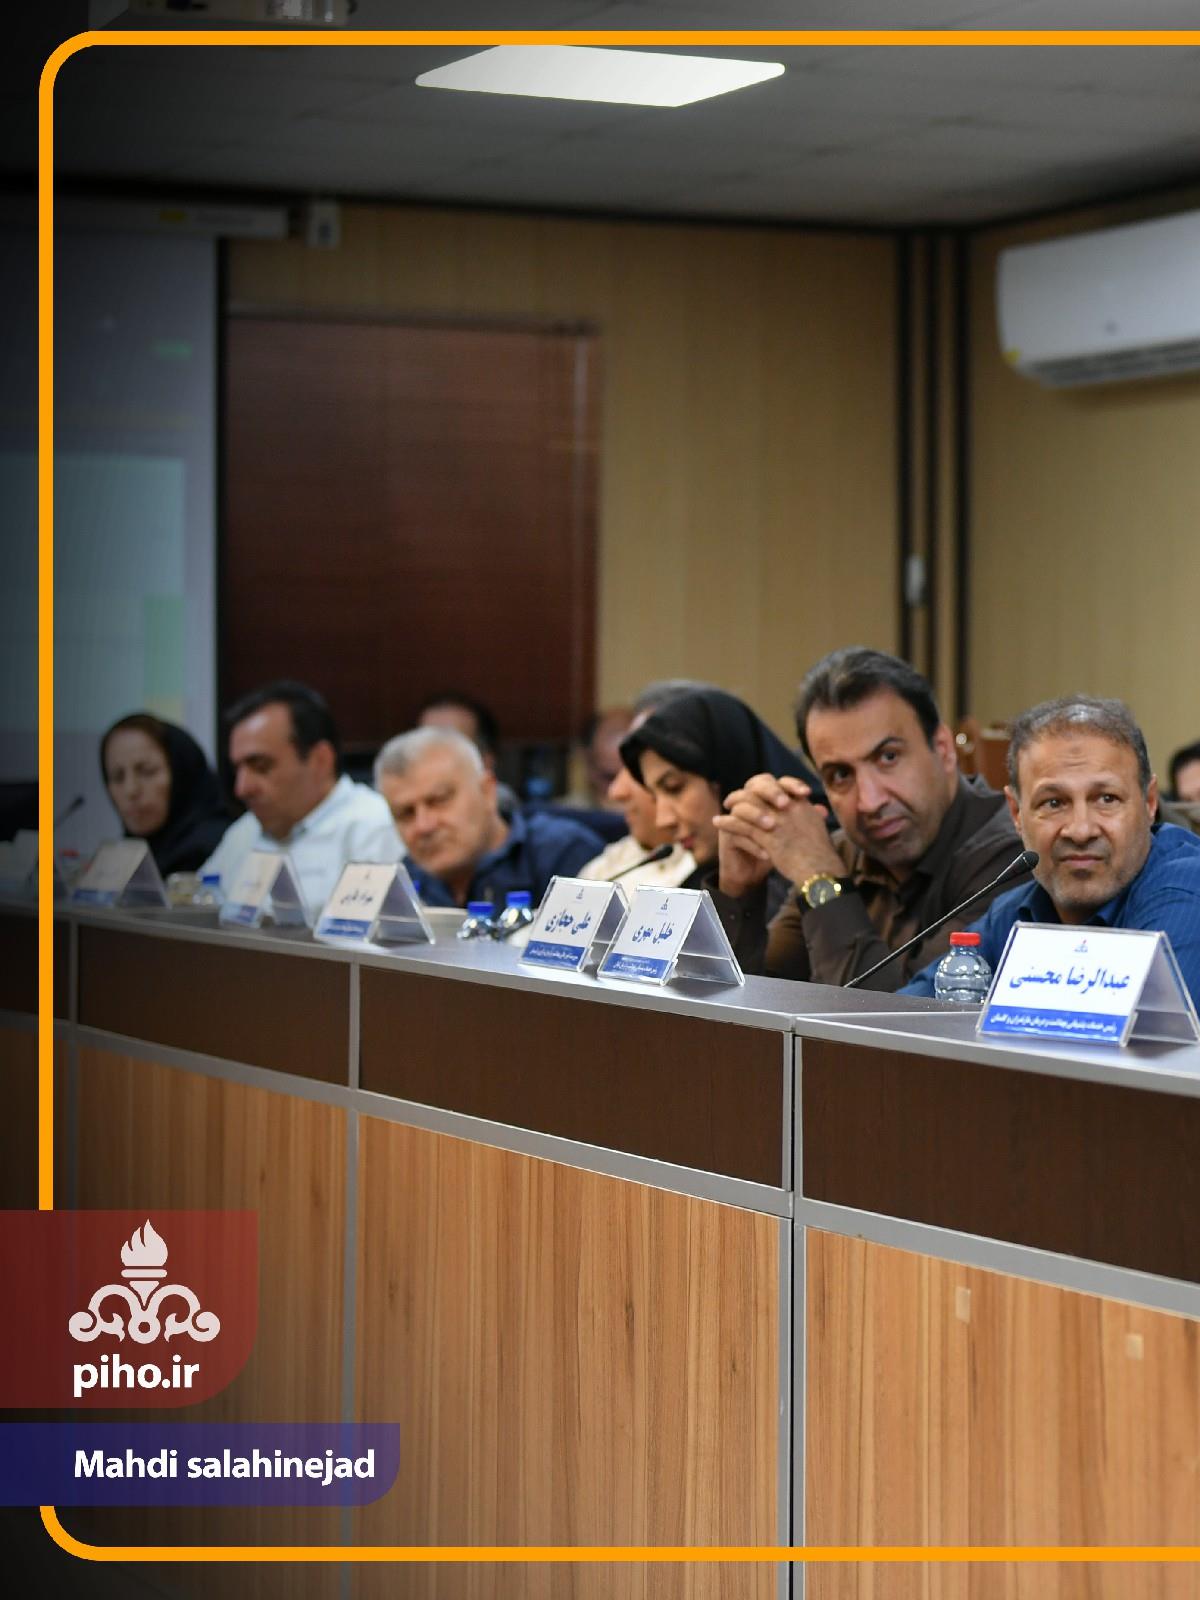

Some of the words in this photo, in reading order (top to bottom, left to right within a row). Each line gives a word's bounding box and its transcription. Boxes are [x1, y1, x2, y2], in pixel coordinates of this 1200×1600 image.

[571, 911, 592, 935] علی
[652, 922, 675, 945] خلیل
[1008, 965, 1063, 988] محسنی
[1066, 965, 1131, 996] عبدالرضا
